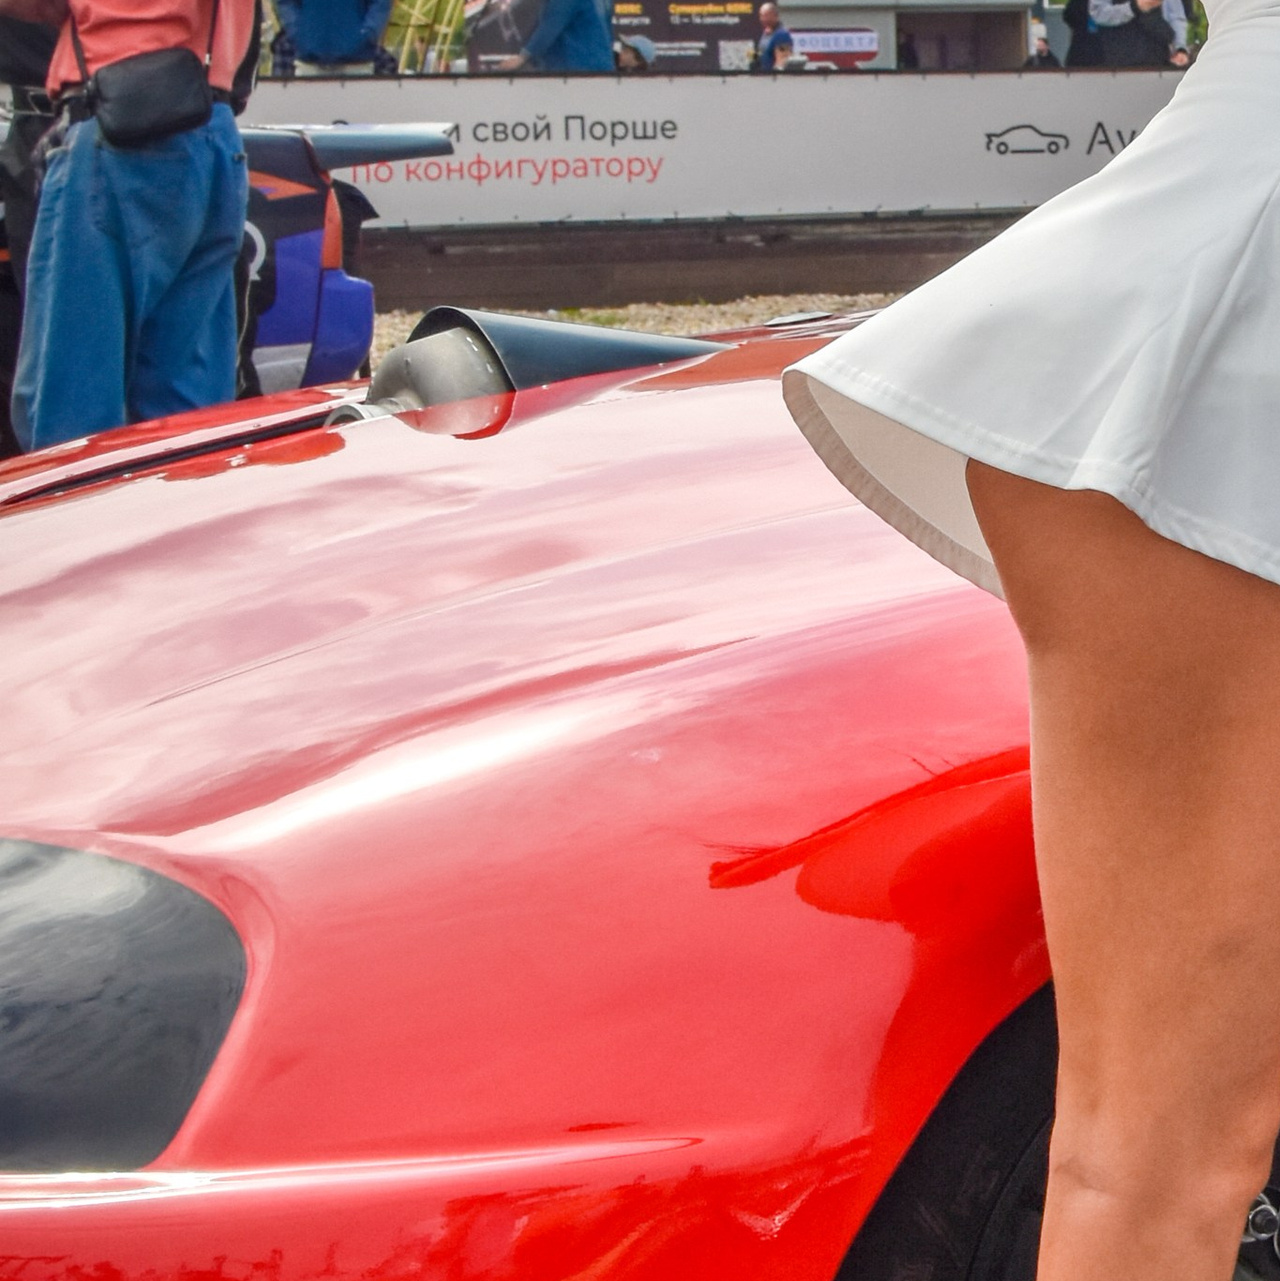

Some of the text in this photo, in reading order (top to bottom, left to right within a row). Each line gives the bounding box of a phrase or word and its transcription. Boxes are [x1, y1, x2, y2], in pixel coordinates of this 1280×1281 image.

[799, 35, 876, 48] ФОЦЕНТР
[472, 114, 551, 142] свой
[564, 115, 678, 146] Порше
[405, 153, 664, 187] конфигуратору
